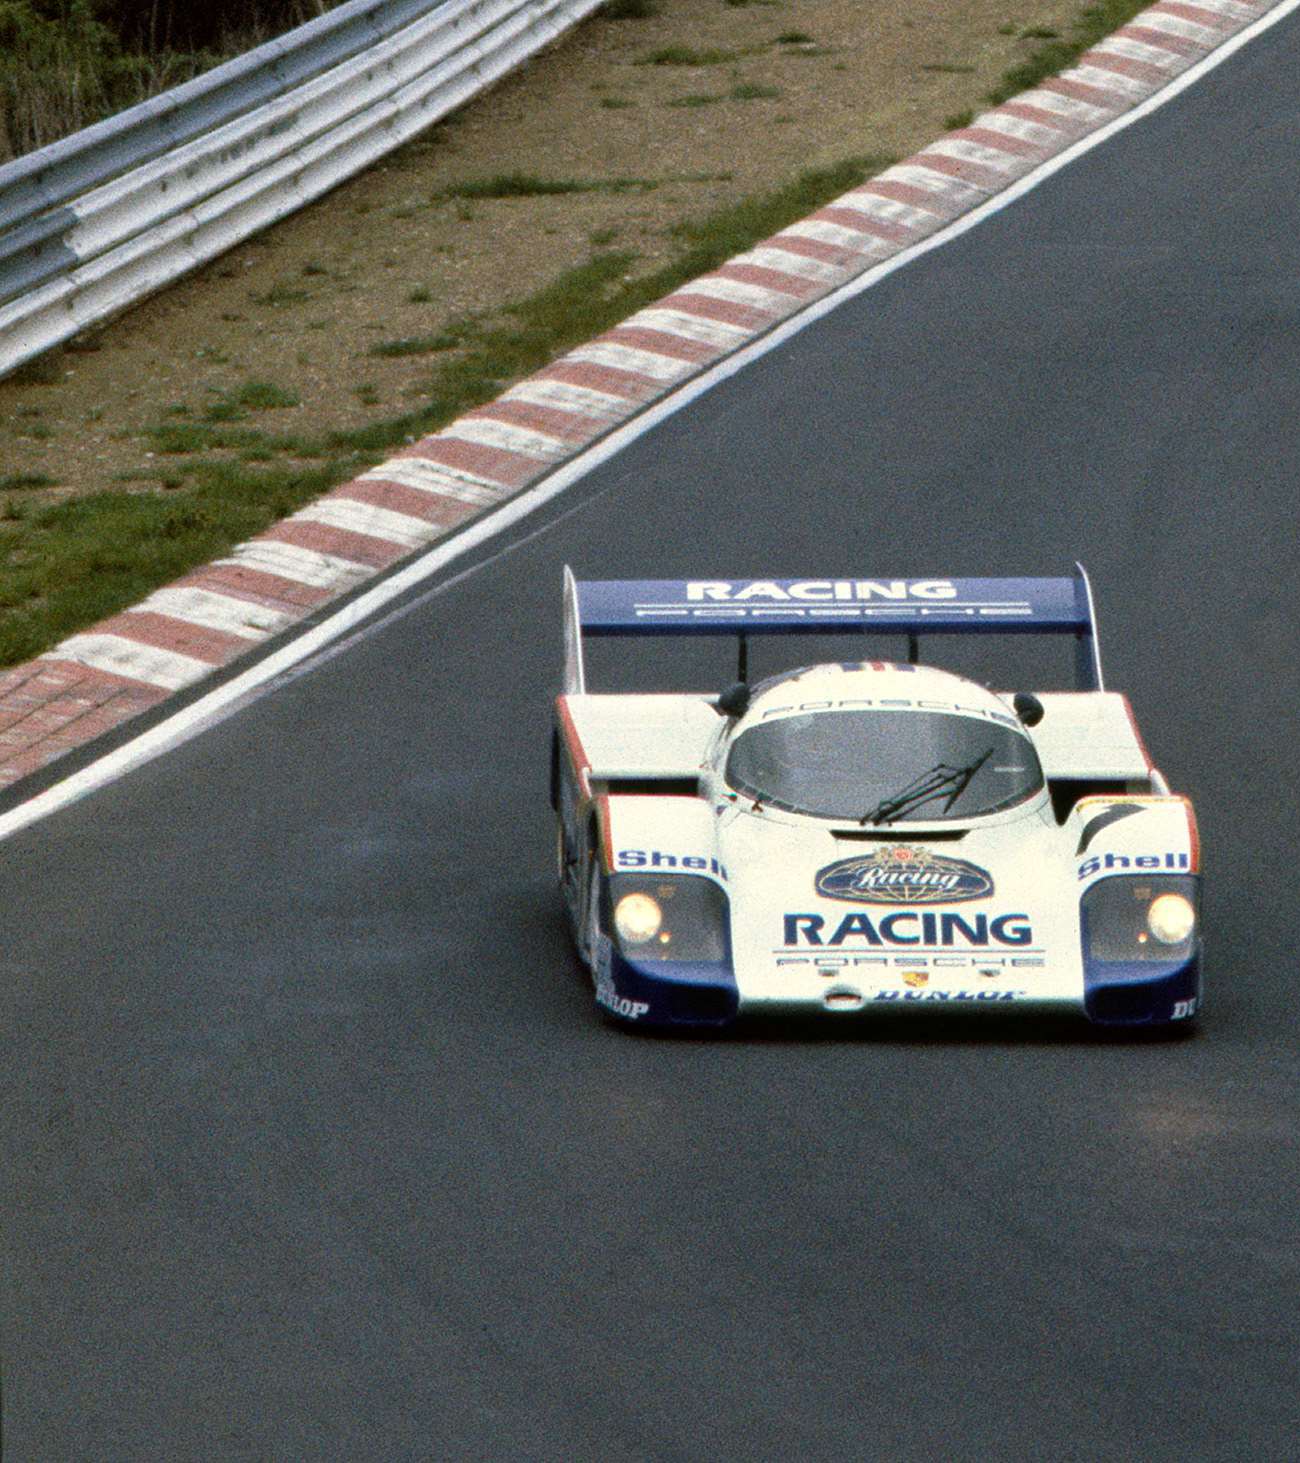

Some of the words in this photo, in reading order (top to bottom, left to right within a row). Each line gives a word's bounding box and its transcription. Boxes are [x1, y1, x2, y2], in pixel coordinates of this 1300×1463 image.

[687, 580, 957, 600] RACING
[762, 699, 1019, 727] PORSCHE
[617, 849, 728, 881] Shell
[852, 867, 960, 889] Racing
[1078, 853, 1188, 880] Shell
[783, 912, 1033, 946] RACING
[776, 957, 1045, 967] PORSCHE
